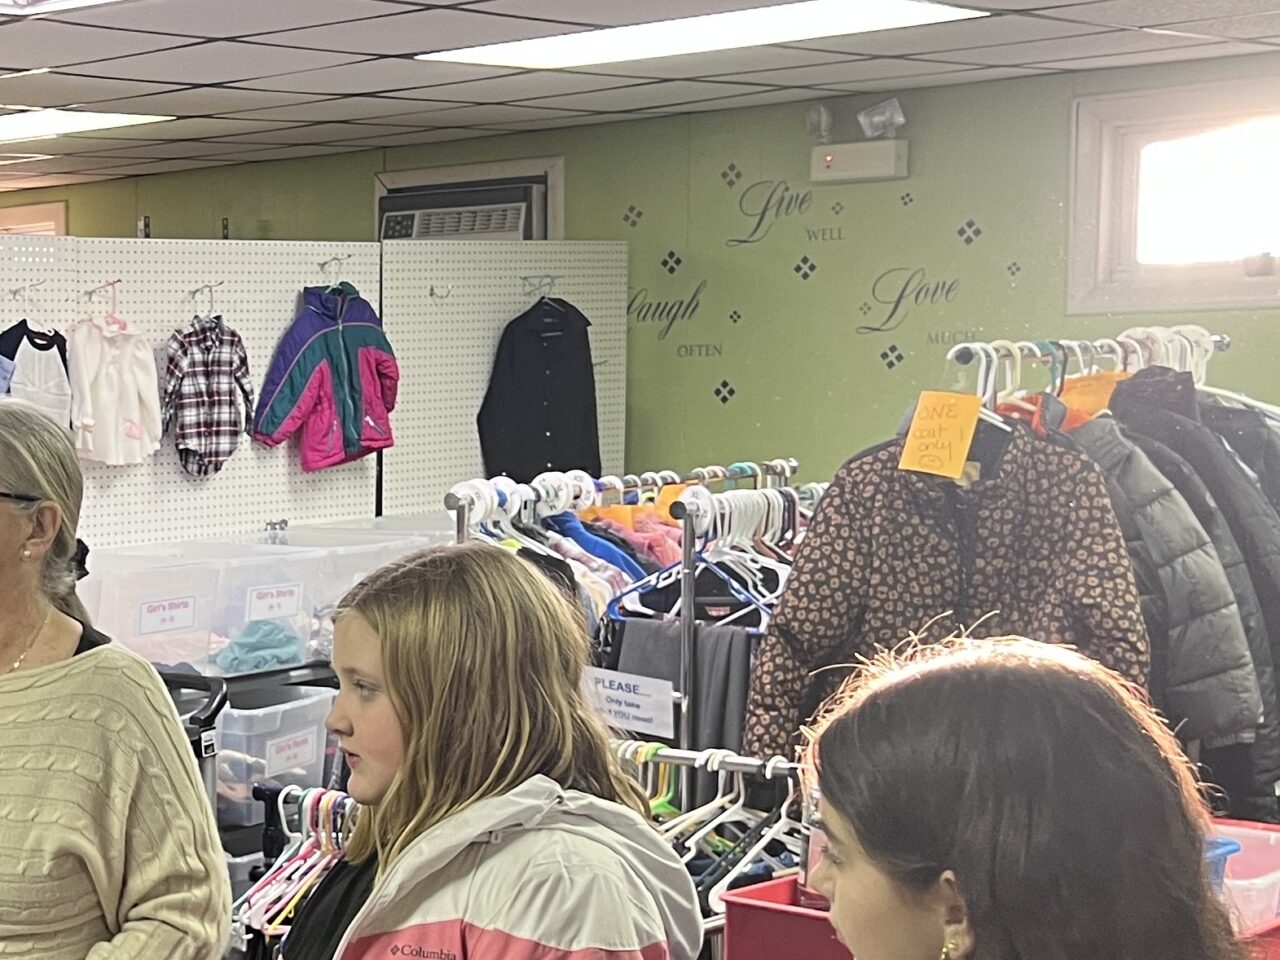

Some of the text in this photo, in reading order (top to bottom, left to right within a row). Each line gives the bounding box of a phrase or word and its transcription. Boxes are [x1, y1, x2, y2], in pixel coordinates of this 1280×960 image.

[725, 180, 813, 247] Live
[806, 227, 845, 241] WELL
[855, 267, 960, 334] Love
[926, 330, 976, 345] MUCH
[676, 343, 723, 358] OFTEN
[917, 403, 959, 421] ONE
[912, 423, 949, 440] coat
[917, 439, 953, 463] only
[605, 695, 622, 707] Only
[614, 710, 630, 720] YOU
